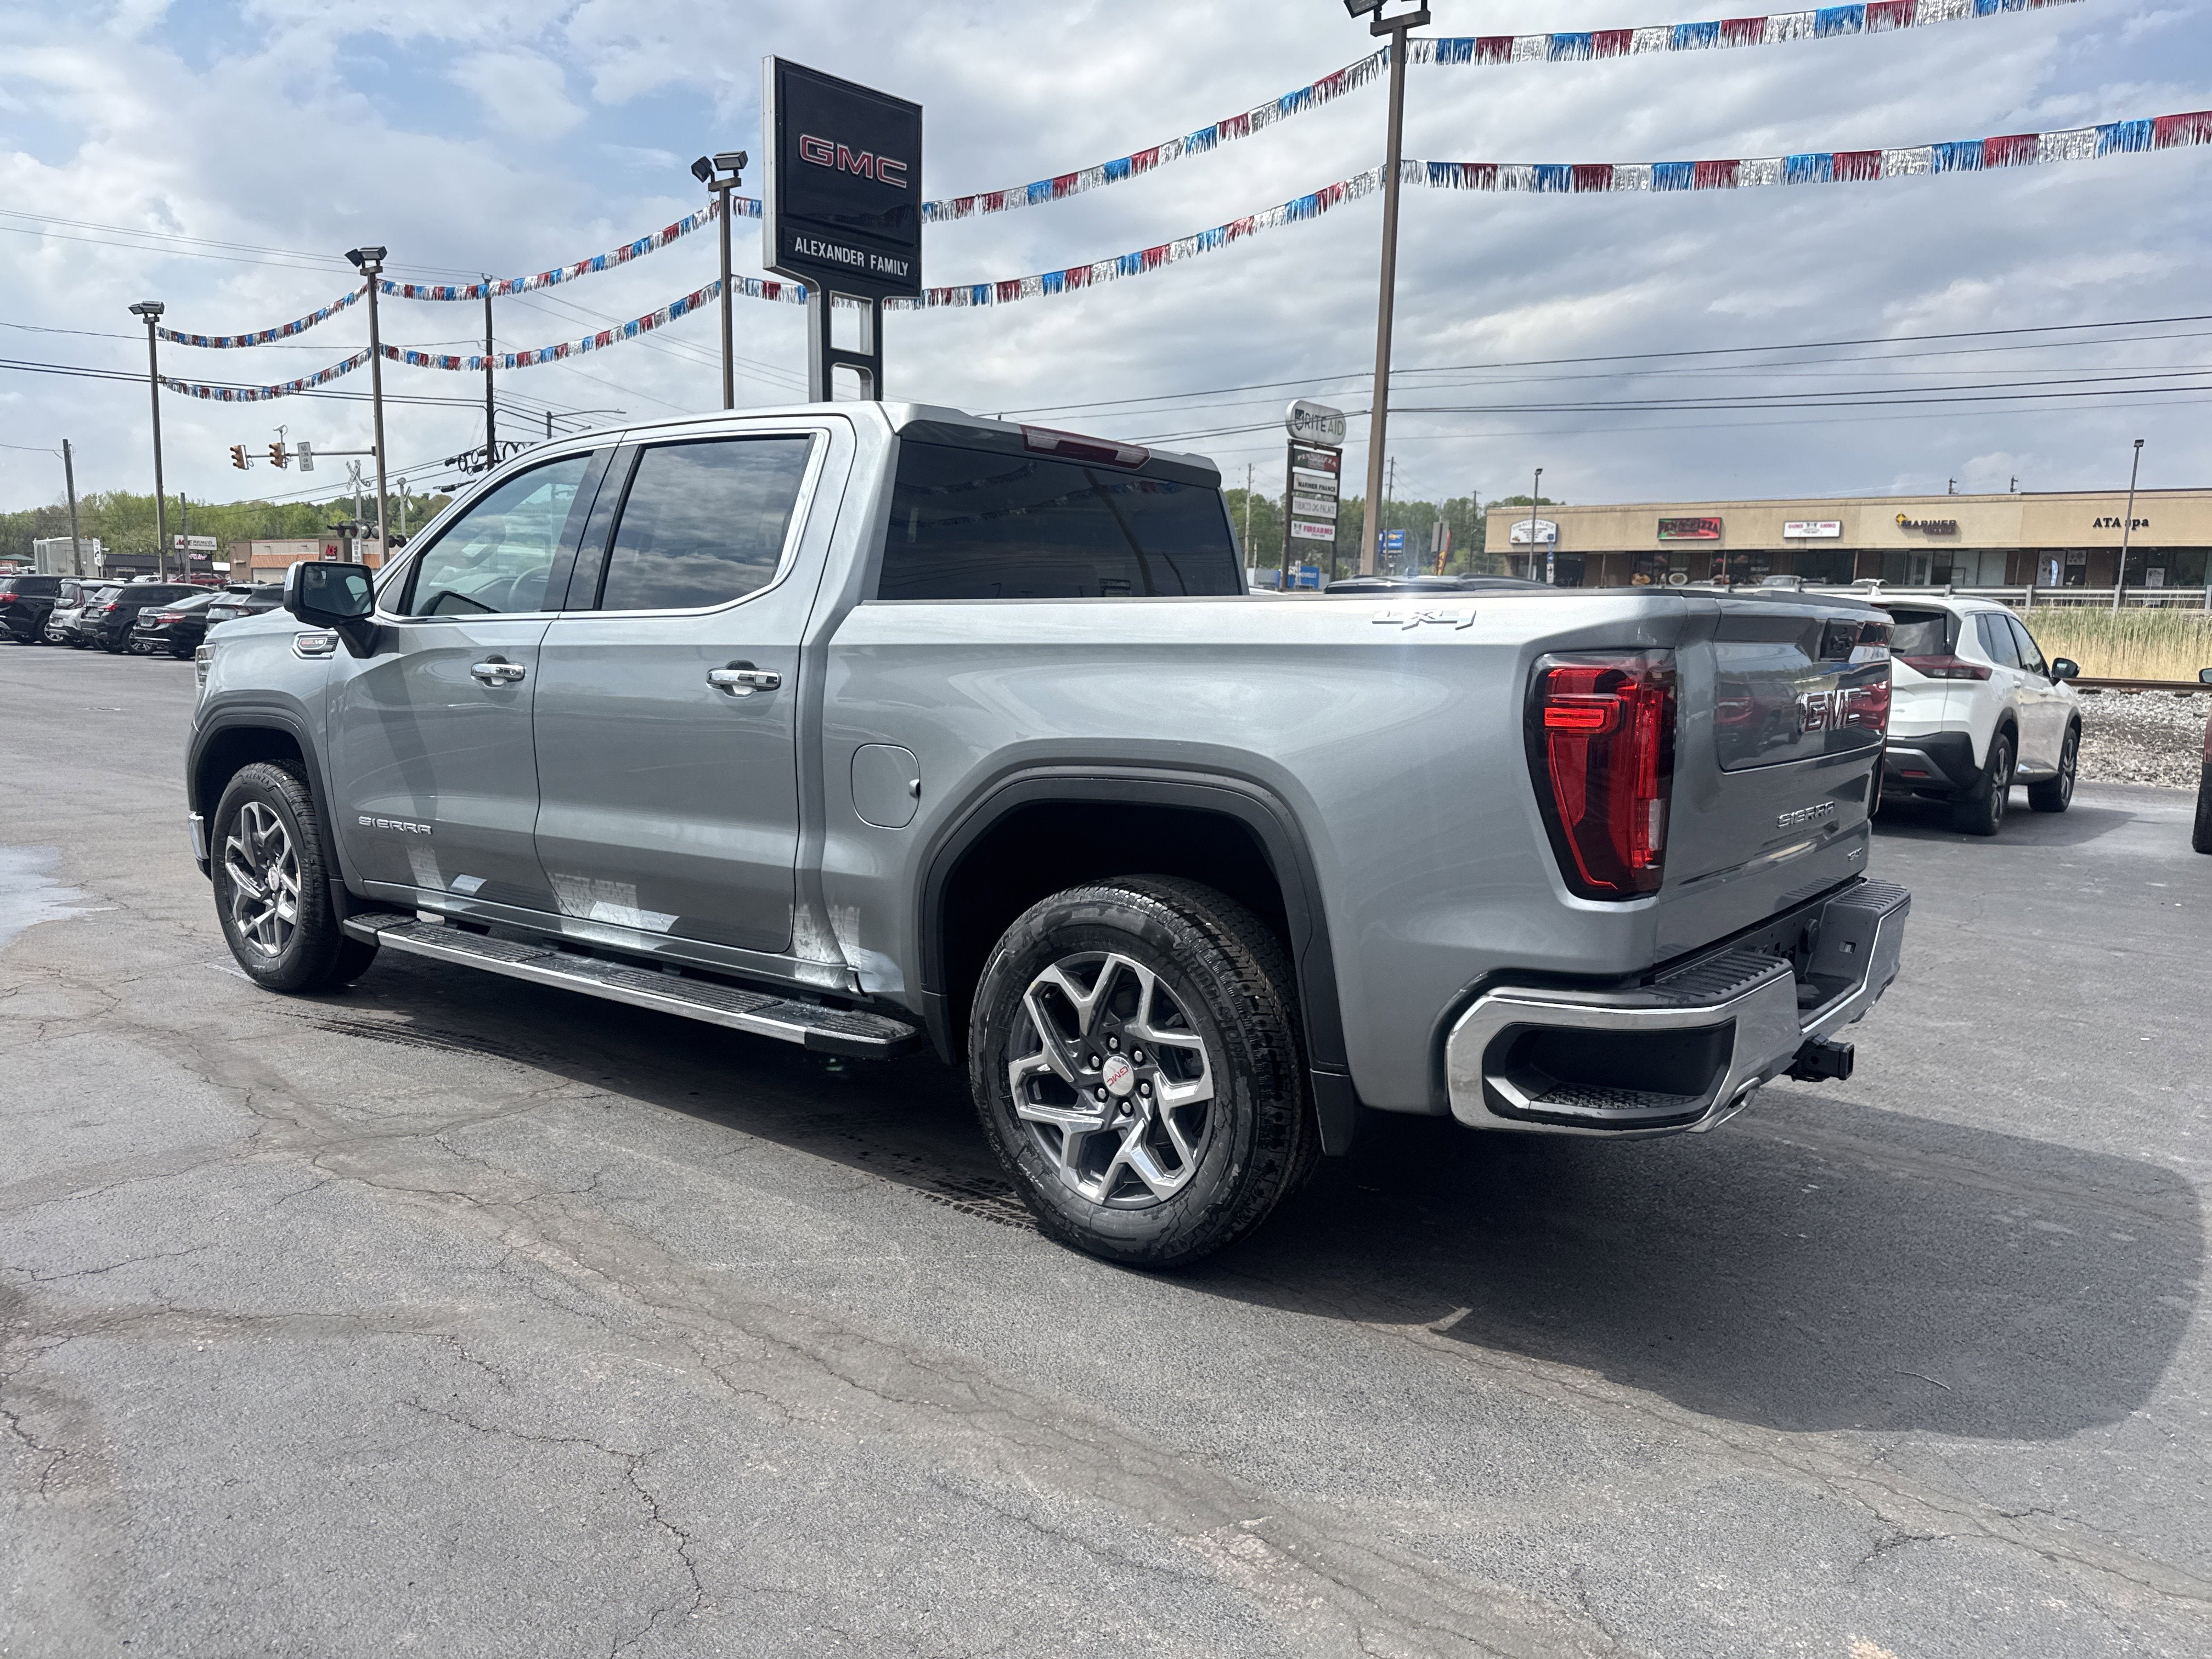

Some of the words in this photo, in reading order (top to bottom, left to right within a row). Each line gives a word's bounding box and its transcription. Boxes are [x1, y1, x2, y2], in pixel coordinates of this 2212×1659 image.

[800, 134, 907, 188] GMC
[795, 237, 865, 267] ALEXANDER
[870, 255, 909, 276] FAMILY
[1305, 413, 1327, 433] RITE
[1328, 419, 1344, 436] AID
[1319, 484, 1336, 493] FINANCE
[1303, 525, 1333, 535] FIREARMS
[2092, 517, 2121, 527] ATA
[325, 544, 337, 556] ACE
[1801, 688, 1861, 732] GMC
[1777, 801, 1835, 828] SIERRA
[358, 816, 433, 835] SIERRA
[1107, 1066, 1128, 1086] GMC
